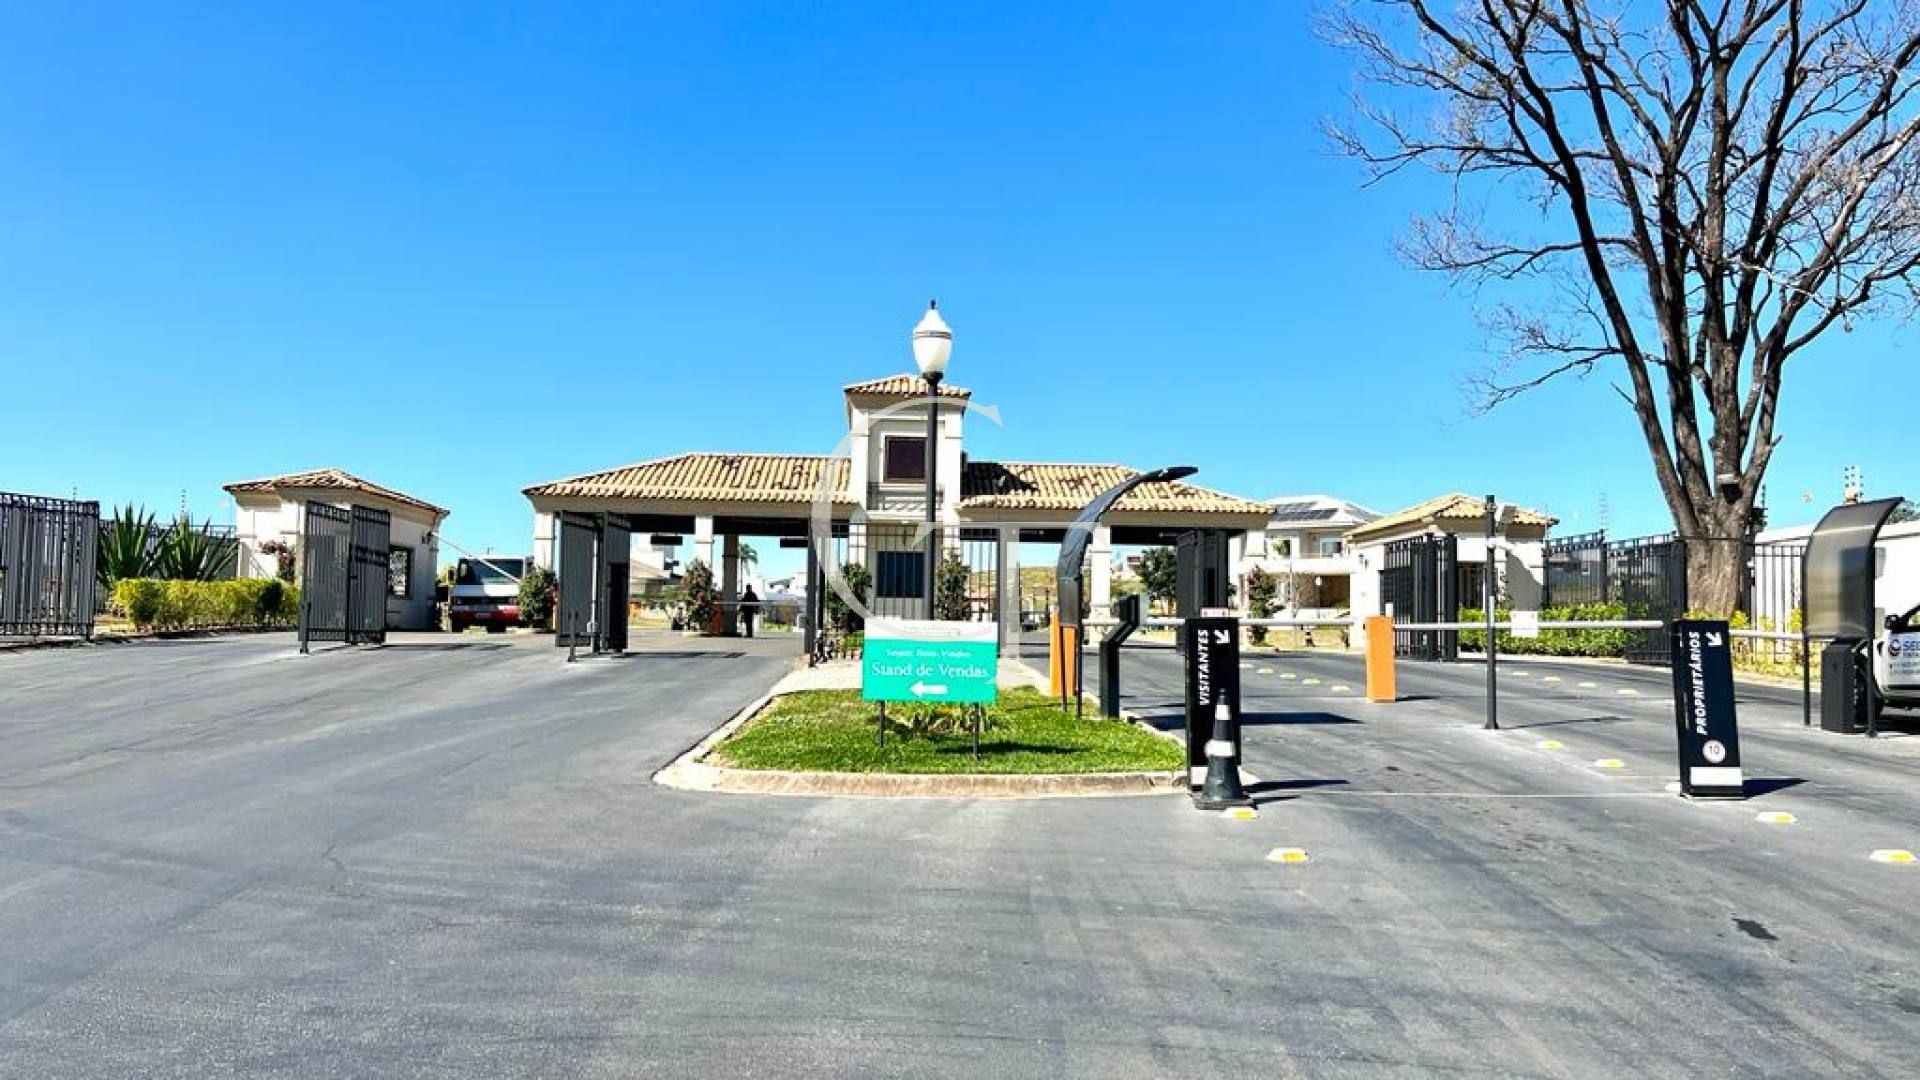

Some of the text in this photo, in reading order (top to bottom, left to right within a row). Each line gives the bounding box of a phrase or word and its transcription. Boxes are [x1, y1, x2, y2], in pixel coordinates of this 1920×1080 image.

[871, 661, 988, 678] Stand de Vendas
[1197, 629, 1210, 706] VISITANTES
[1688, 631, 1708, 736] PROPRIETÁRIOS
[1707, 744, 1720, 754] 10
